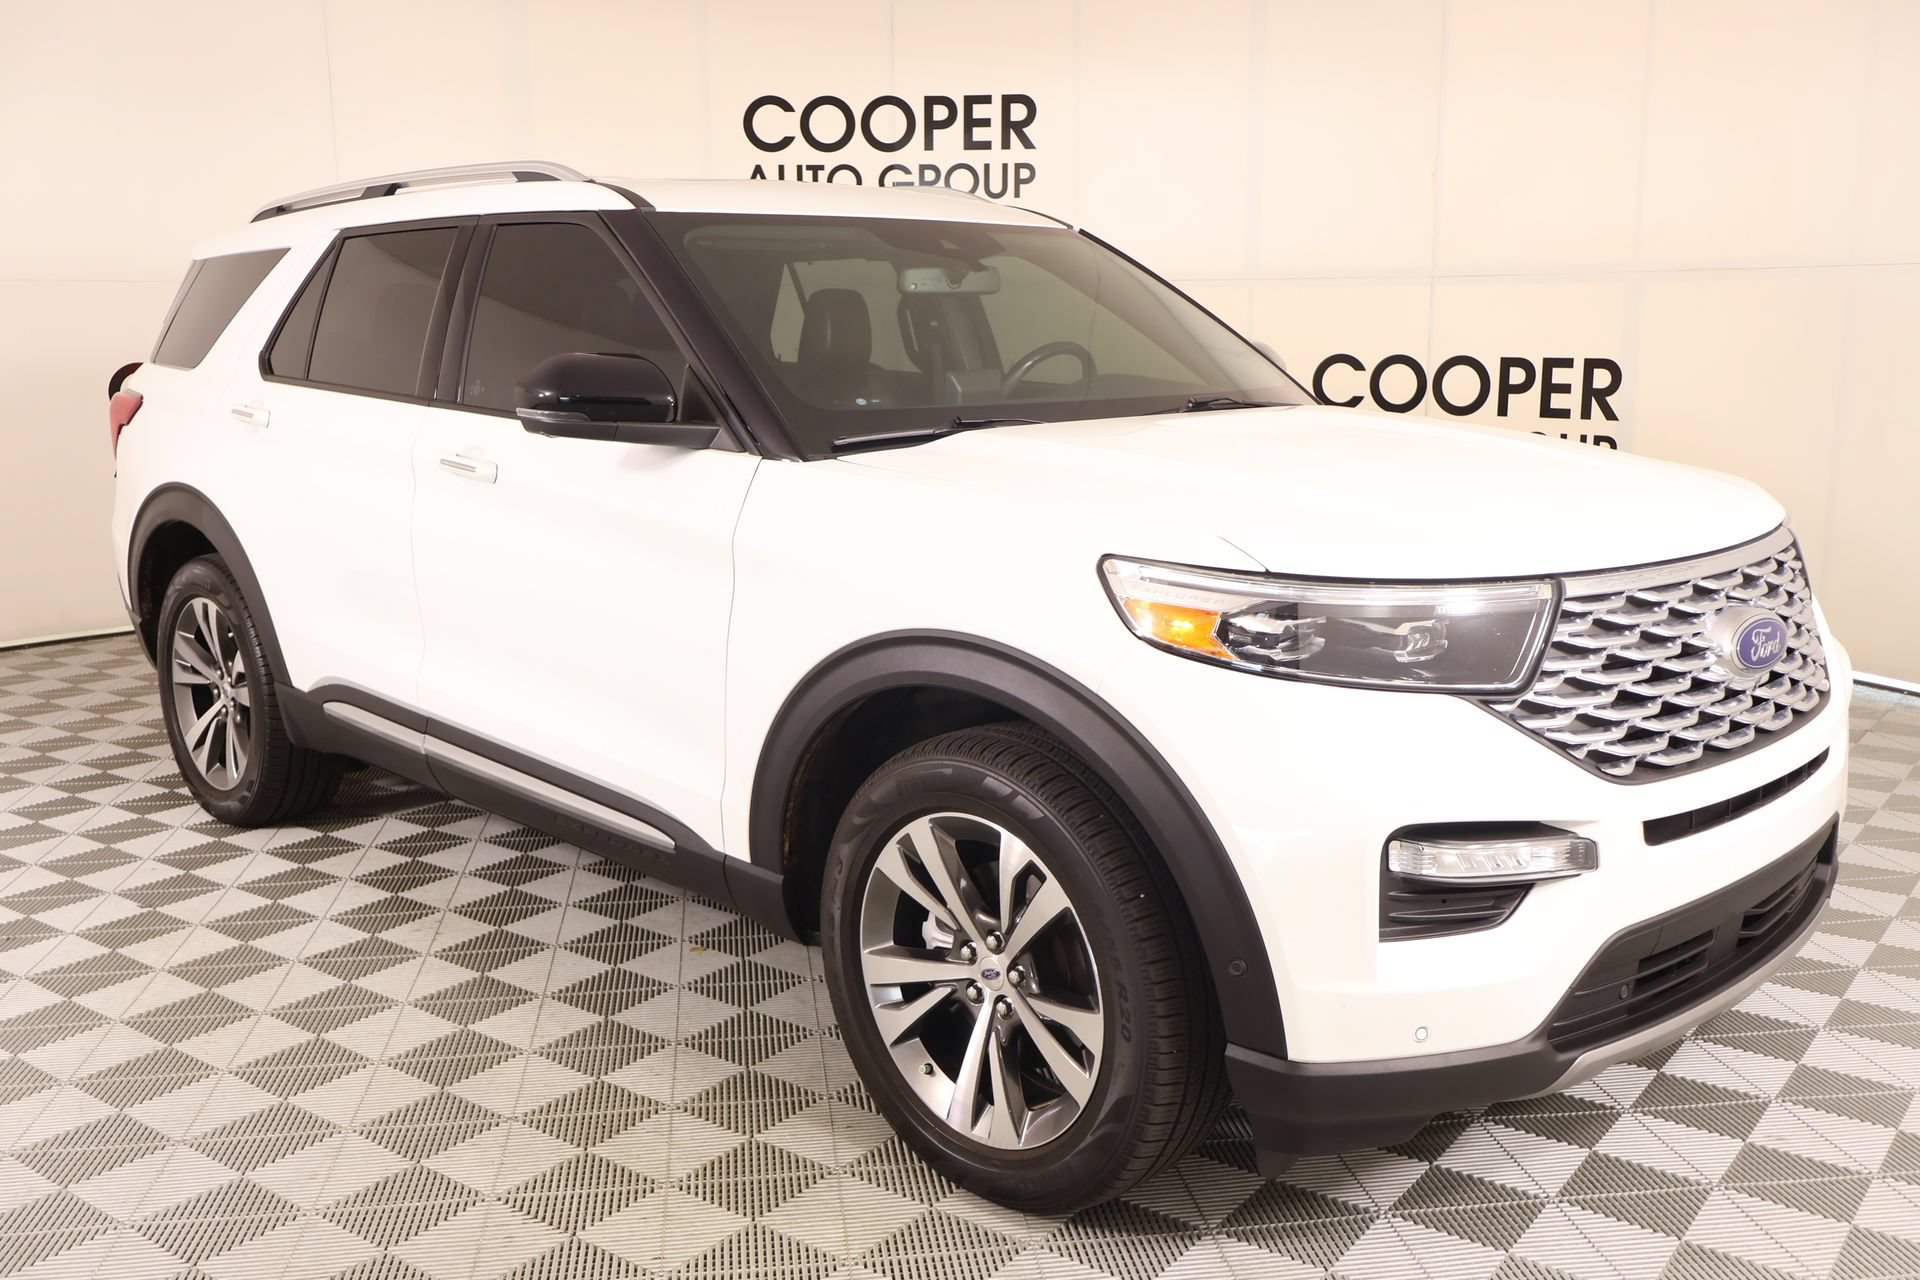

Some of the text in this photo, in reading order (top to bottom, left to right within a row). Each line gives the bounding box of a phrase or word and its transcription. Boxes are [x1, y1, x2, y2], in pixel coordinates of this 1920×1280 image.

[743, 94, 1037, 153] COOPER
[879, 163, 1036, 199] GROUP
[1312, 353, 1623, 421] COOPER
[1751, 626, 1781, 661] Ford
